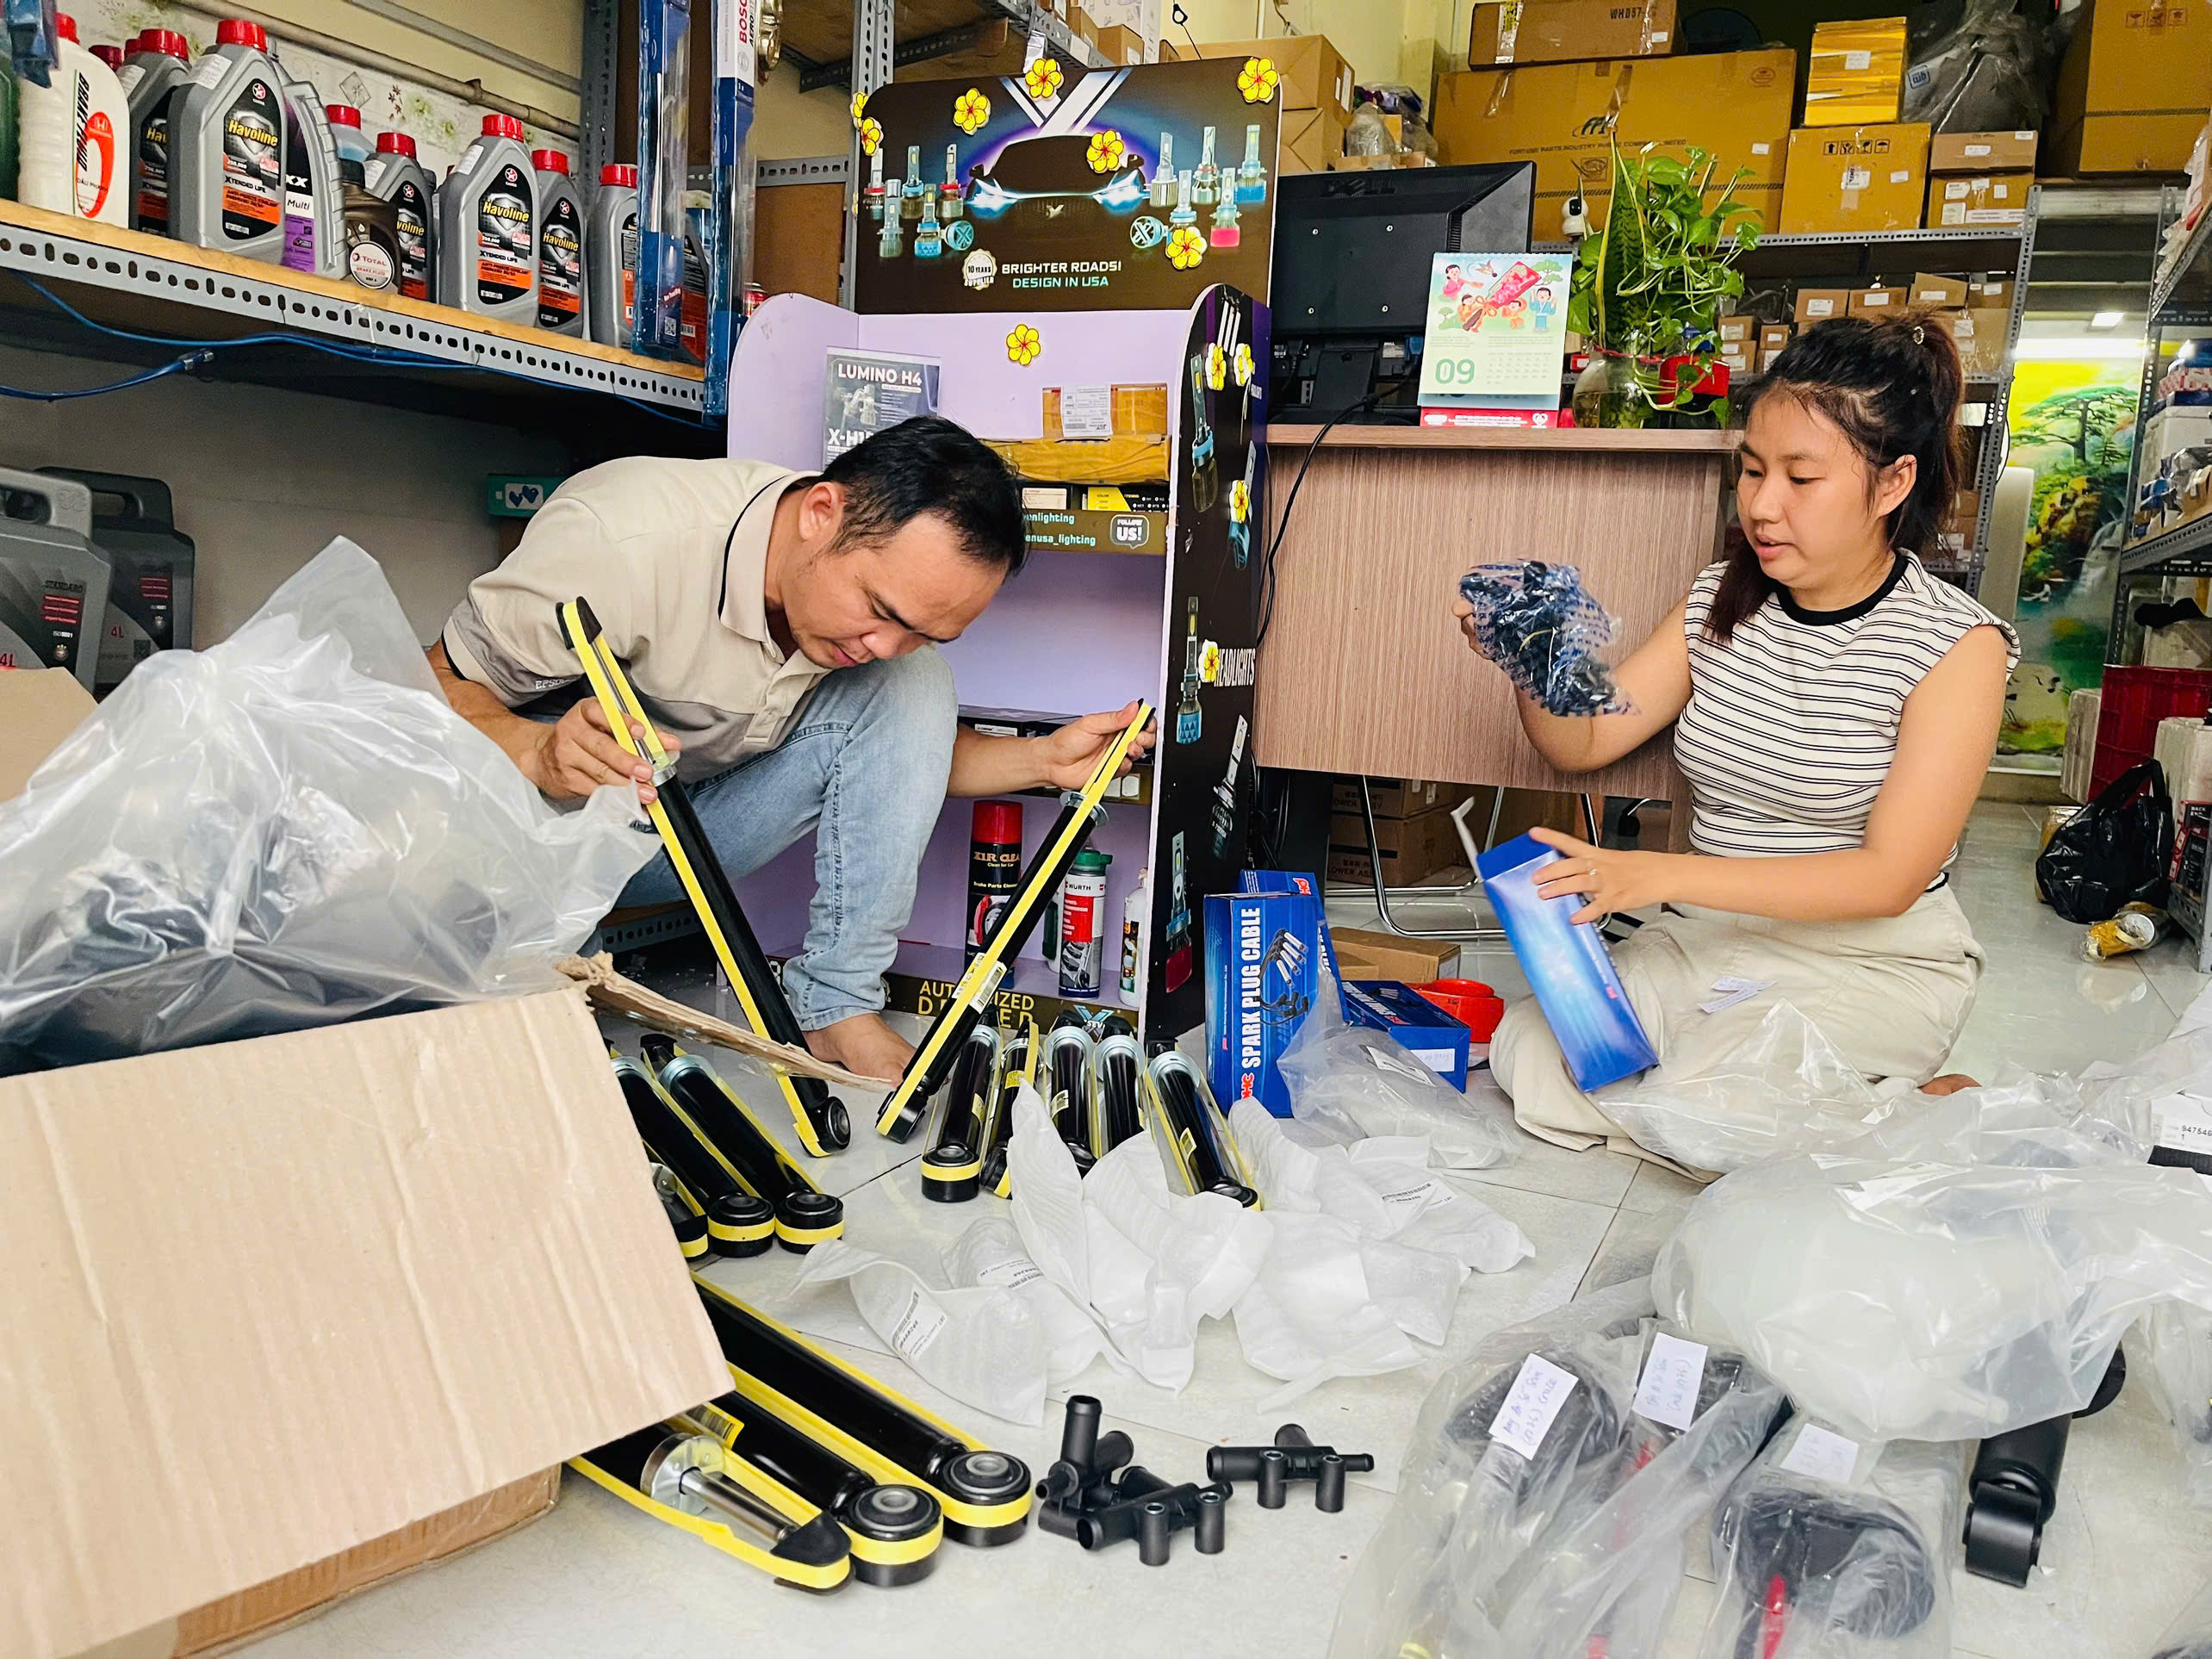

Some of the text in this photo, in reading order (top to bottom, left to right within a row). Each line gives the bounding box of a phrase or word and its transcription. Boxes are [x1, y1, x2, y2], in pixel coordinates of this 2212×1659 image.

[228, 118, 278, 146] Havoline
[287, 199, 310, 211] Multi
[482, 200, 530, 223] Havoline
[396, 221, 425, 236] voline
[543, 233, 579, 252] Havoline
[361, 256, 387, 266] TOTAL
[968, 265, 975, 274] 10
[1002, 260, 1122, 275] BRIGHTER ROADS!
[1012, 276, 1109, 289] DESIGN IN USA
[838, 363, 923, 387] LUMINO H4
[1435, 358, 1476, 385] 09
[1116, 526, 1142, 542] US!
[110, 624, 125, 638] 4L
[1214, 648, 1256, 687] EADLIGHTS
[919, 979, 1035, 1011] AUTIZED
[1240, 907, 1261, 1069] SPARK PLUG CABLE
